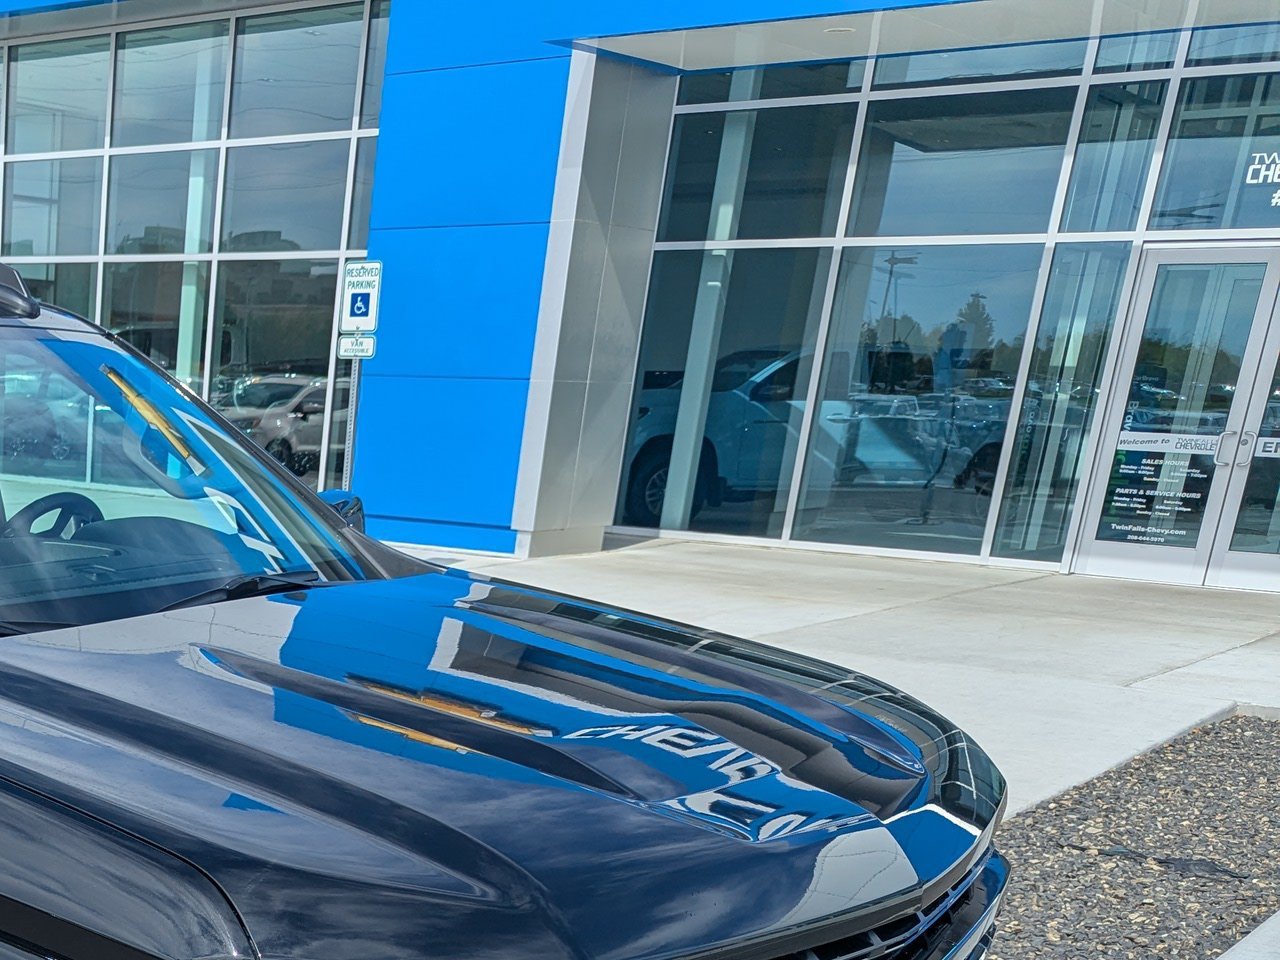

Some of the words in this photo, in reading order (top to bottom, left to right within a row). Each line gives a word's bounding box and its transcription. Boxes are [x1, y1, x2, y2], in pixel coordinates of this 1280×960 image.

[346, 267, 379, 278] RESERVED
[347, 280, 376, 289] PARKING
[1115, 487, 1137, 495] PARTS
[1145, 489, 1175, 497] SERVICE
[1111, 524, 1186, 536] TwinFalls-Chevy.com
